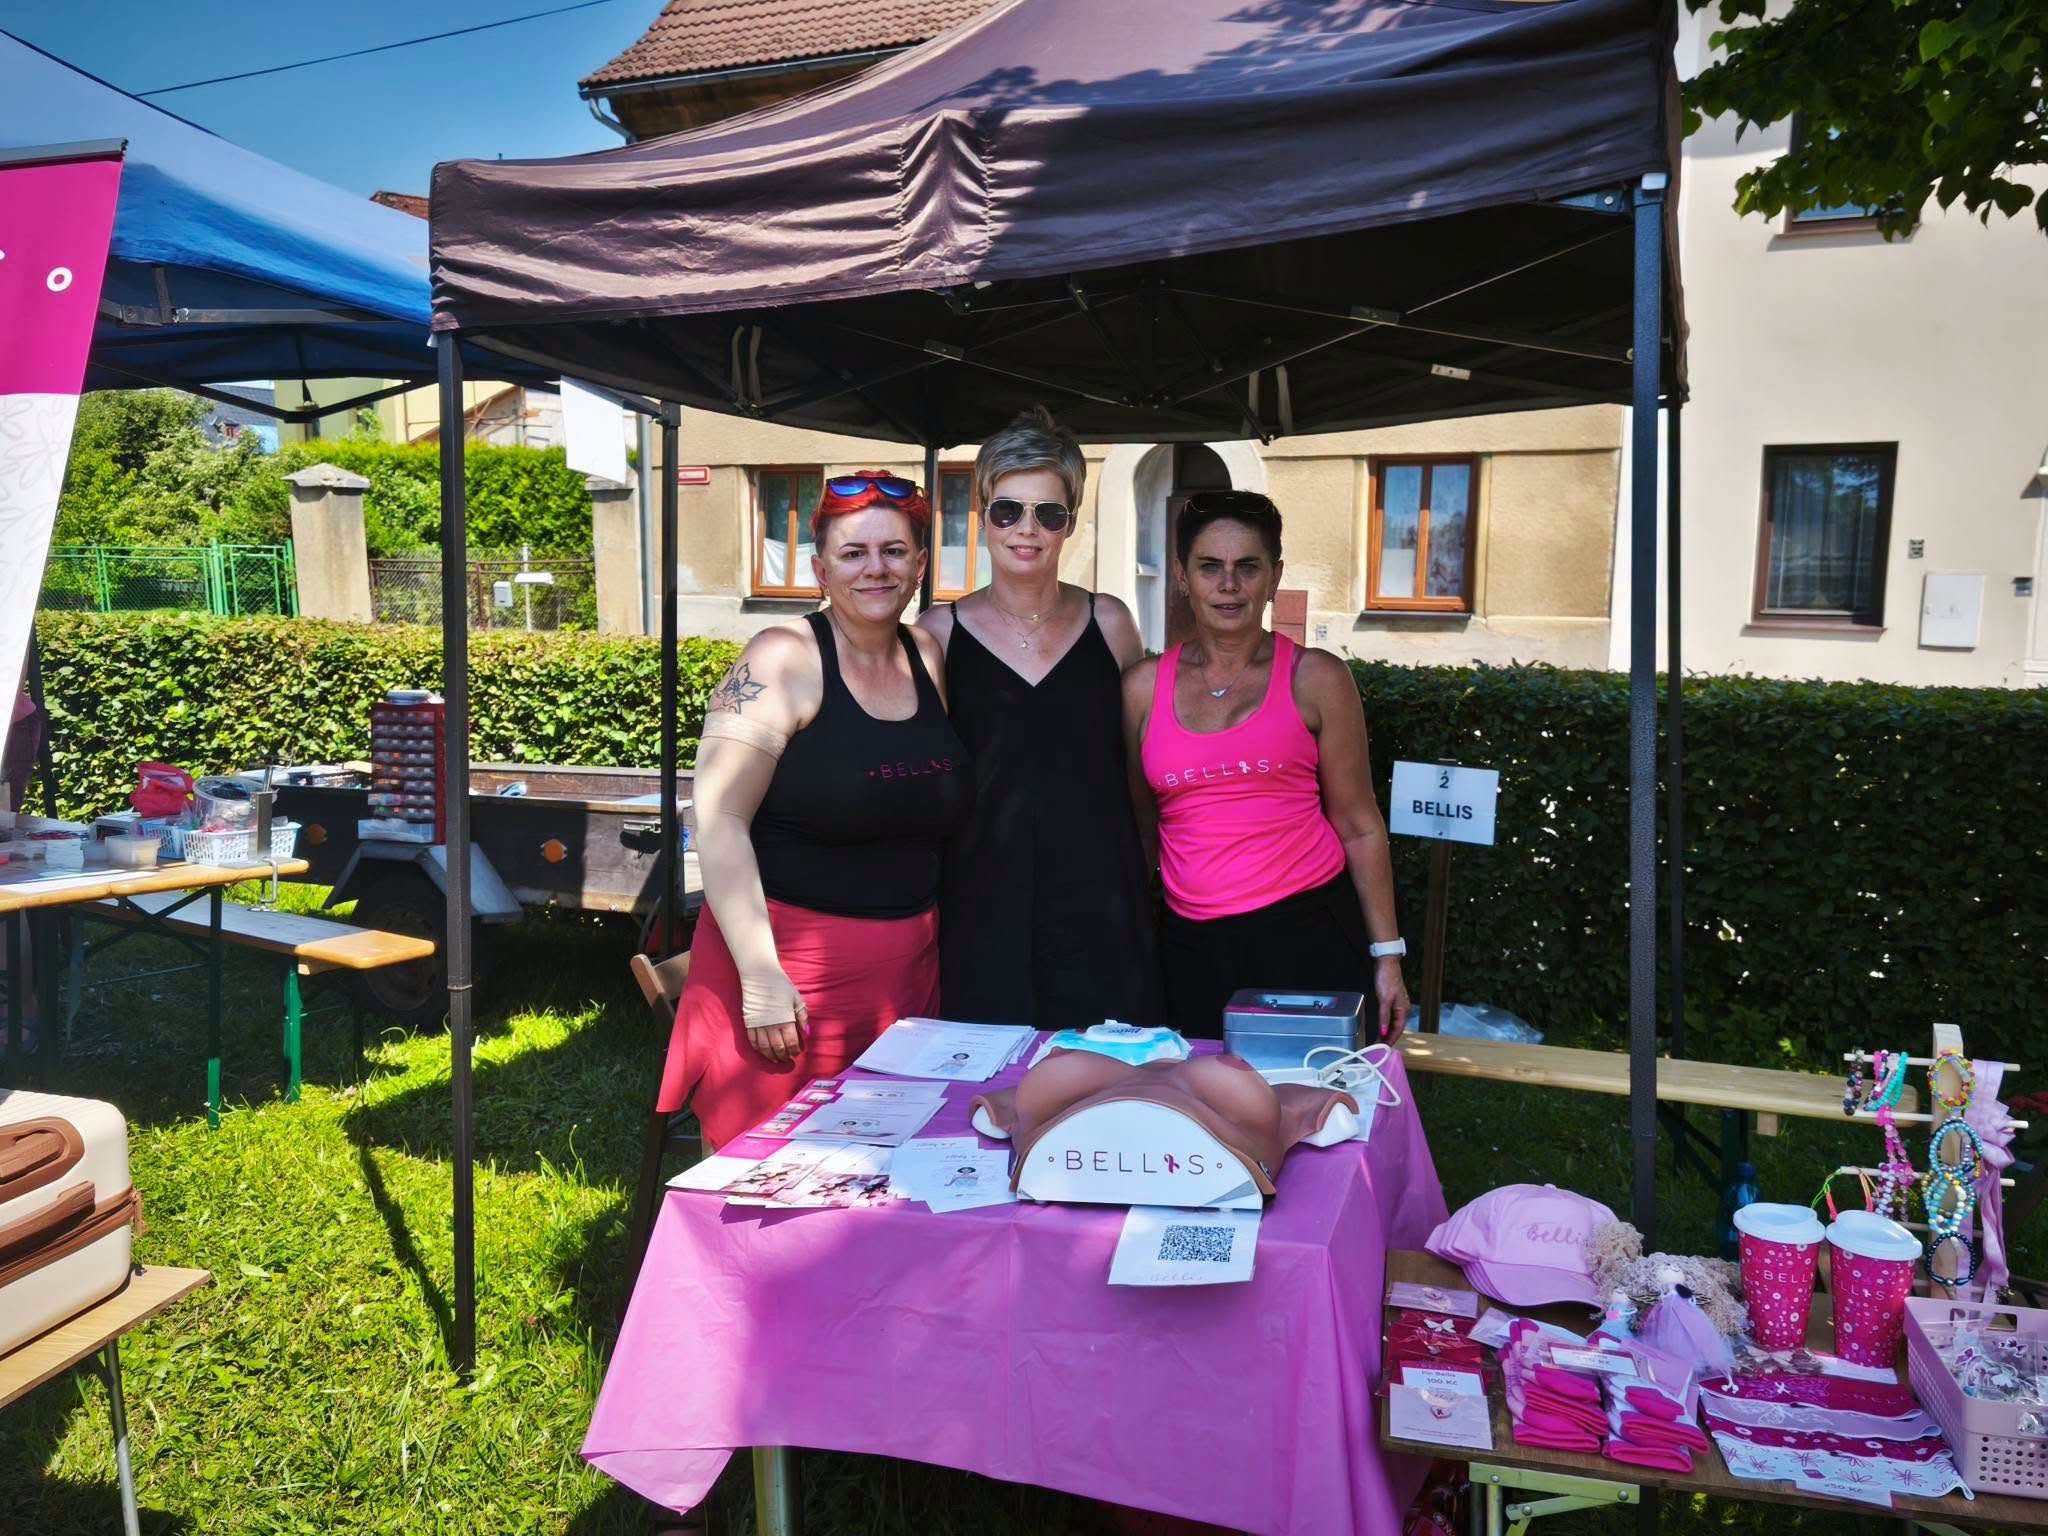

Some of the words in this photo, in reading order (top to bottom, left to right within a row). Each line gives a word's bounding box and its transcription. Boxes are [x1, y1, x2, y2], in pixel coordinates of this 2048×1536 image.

[1439, 775, 1450, 789] 2
[1412, 799, 1473, 820] BELLIS
[1526, 1223, 1583, 1245] Belli
[1427, 1377, 1443, 1385] 100
